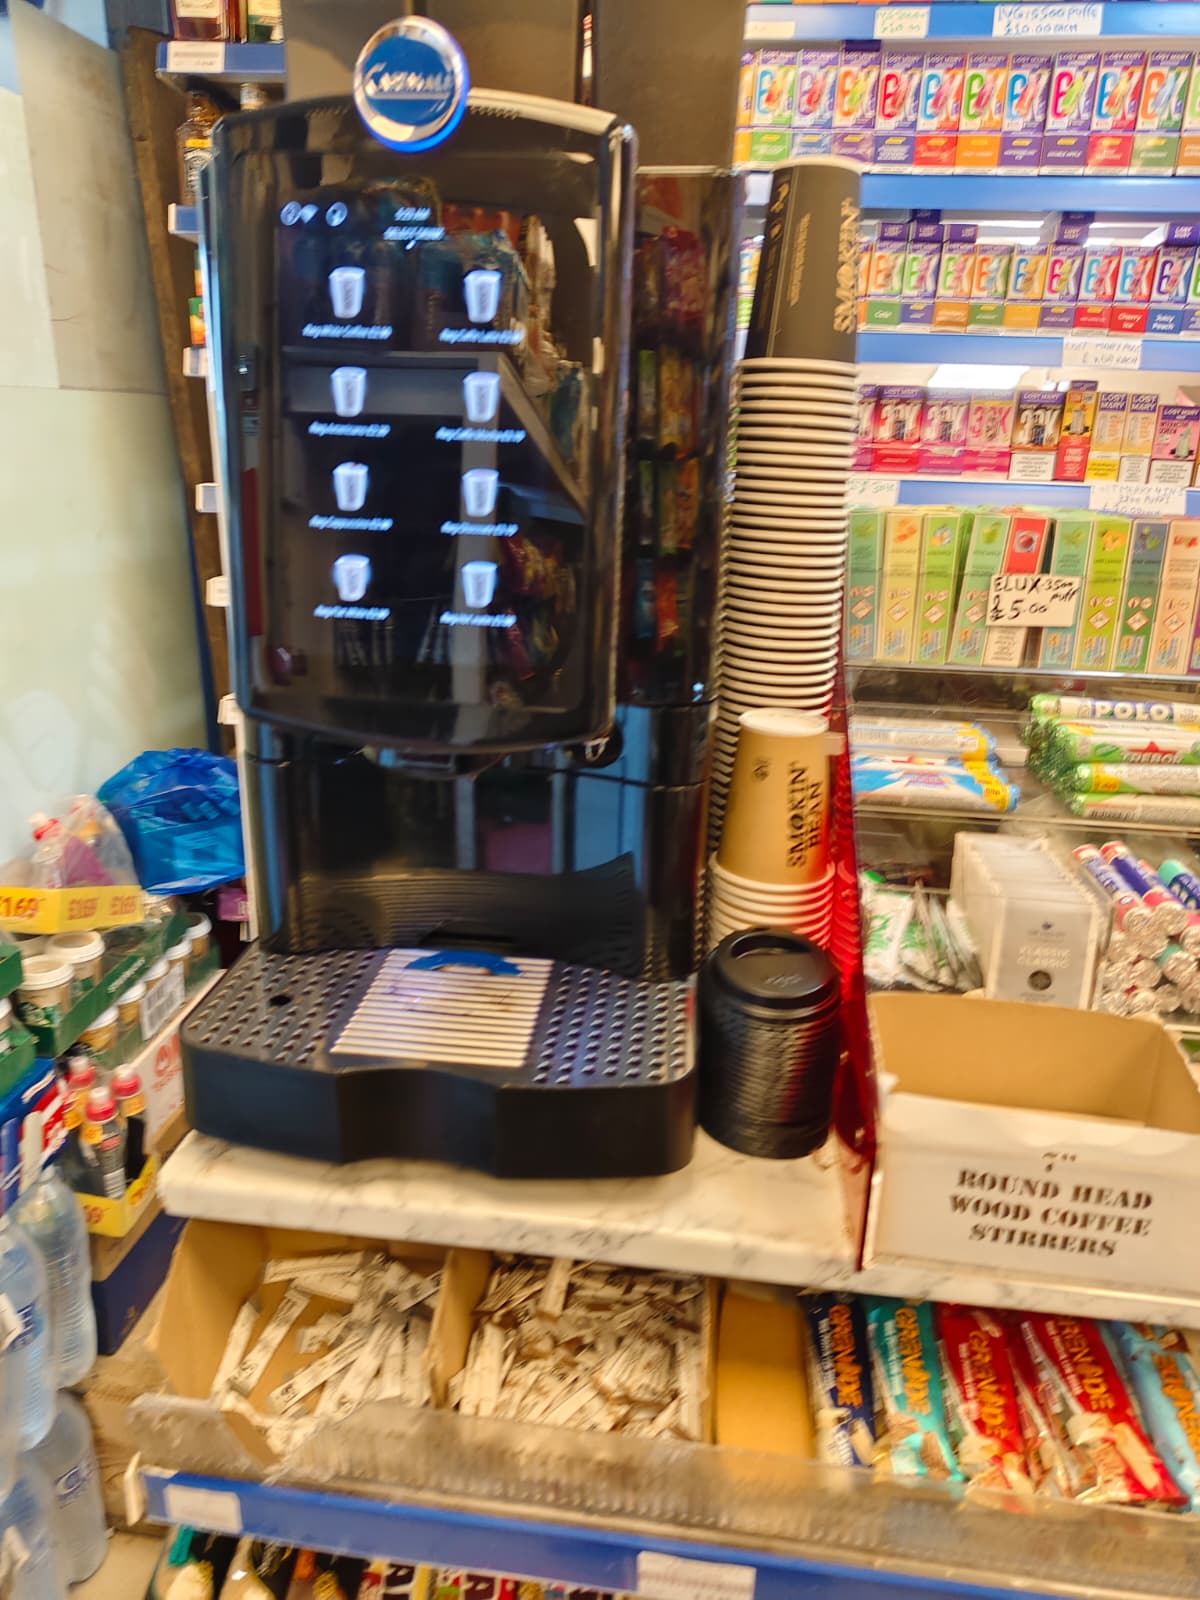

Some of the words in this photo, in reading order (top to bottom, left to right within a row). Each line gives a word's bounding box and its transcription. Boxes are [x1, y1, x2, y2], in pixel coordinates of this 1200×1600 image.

[994, 576, 1041, 593] ELUX
[989, 594, 1048, 622] £5.00
[1094, 700, 1173, 722] POLO
[957, 1169, 1060, 1199] ROUND
[1071, 1185, 1154, 1210] HEAD
[950, 1195, 1031, 1221] WOOD
[1040, 1207, 1153, 1237] COFFEE
[968, 1223, 1118, 1257] STIRRERS
[829, 1304, 864, 1408] GRENADE
[895, 1307, 931, 1415] GRENADE
[1057, 1317, 1116, 1410] RENADE
